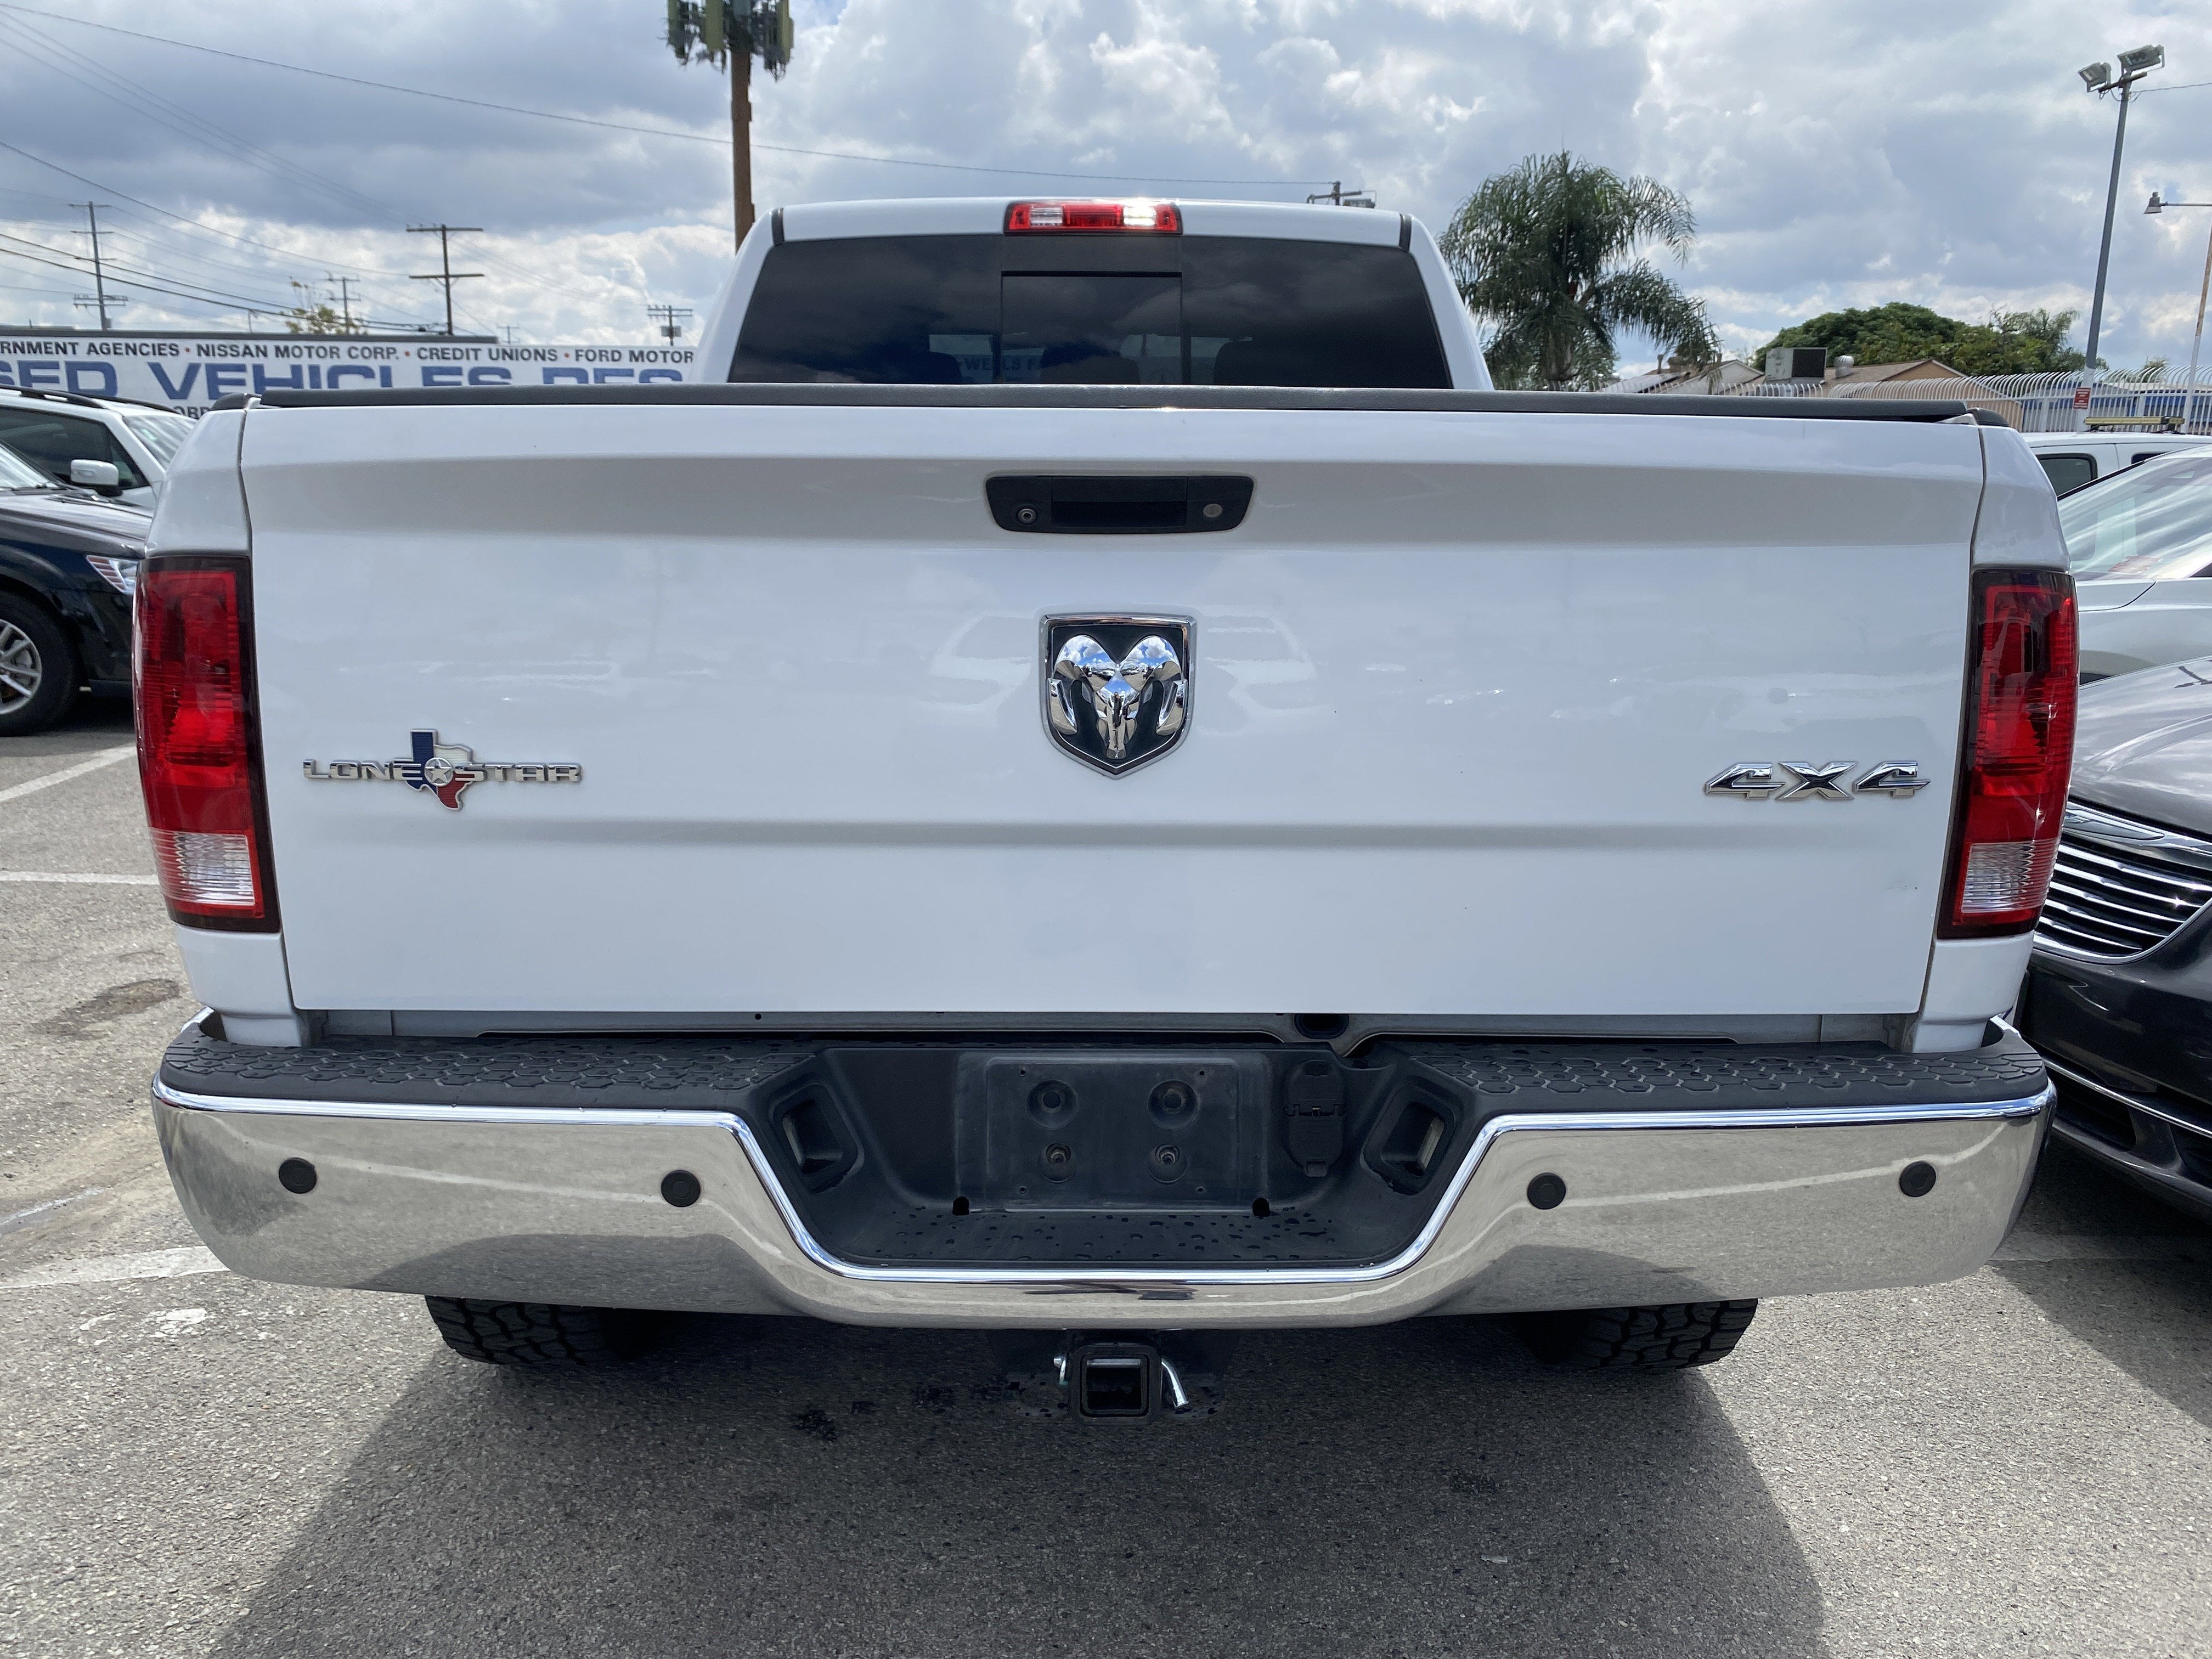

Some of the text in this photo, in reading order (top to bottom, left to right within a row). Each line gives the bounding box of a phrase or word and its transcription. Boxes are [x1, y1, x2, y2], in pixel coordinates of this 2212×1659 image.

[87, 342, 179, 356] AGENCIES
[196, 343, 268, 357] NISSAN
[275, 345, 340, 359] MOTOR
[347, 346, 399, 360] CORP.
[417, 347, 481, 360] CREDIT
[488, 348, 558, 361] UNIONS
[575, 349, 622, 362] FORD
[629, 349, 694, 363] MOTOR
[303, 758, 582, 783] LONE STAR
